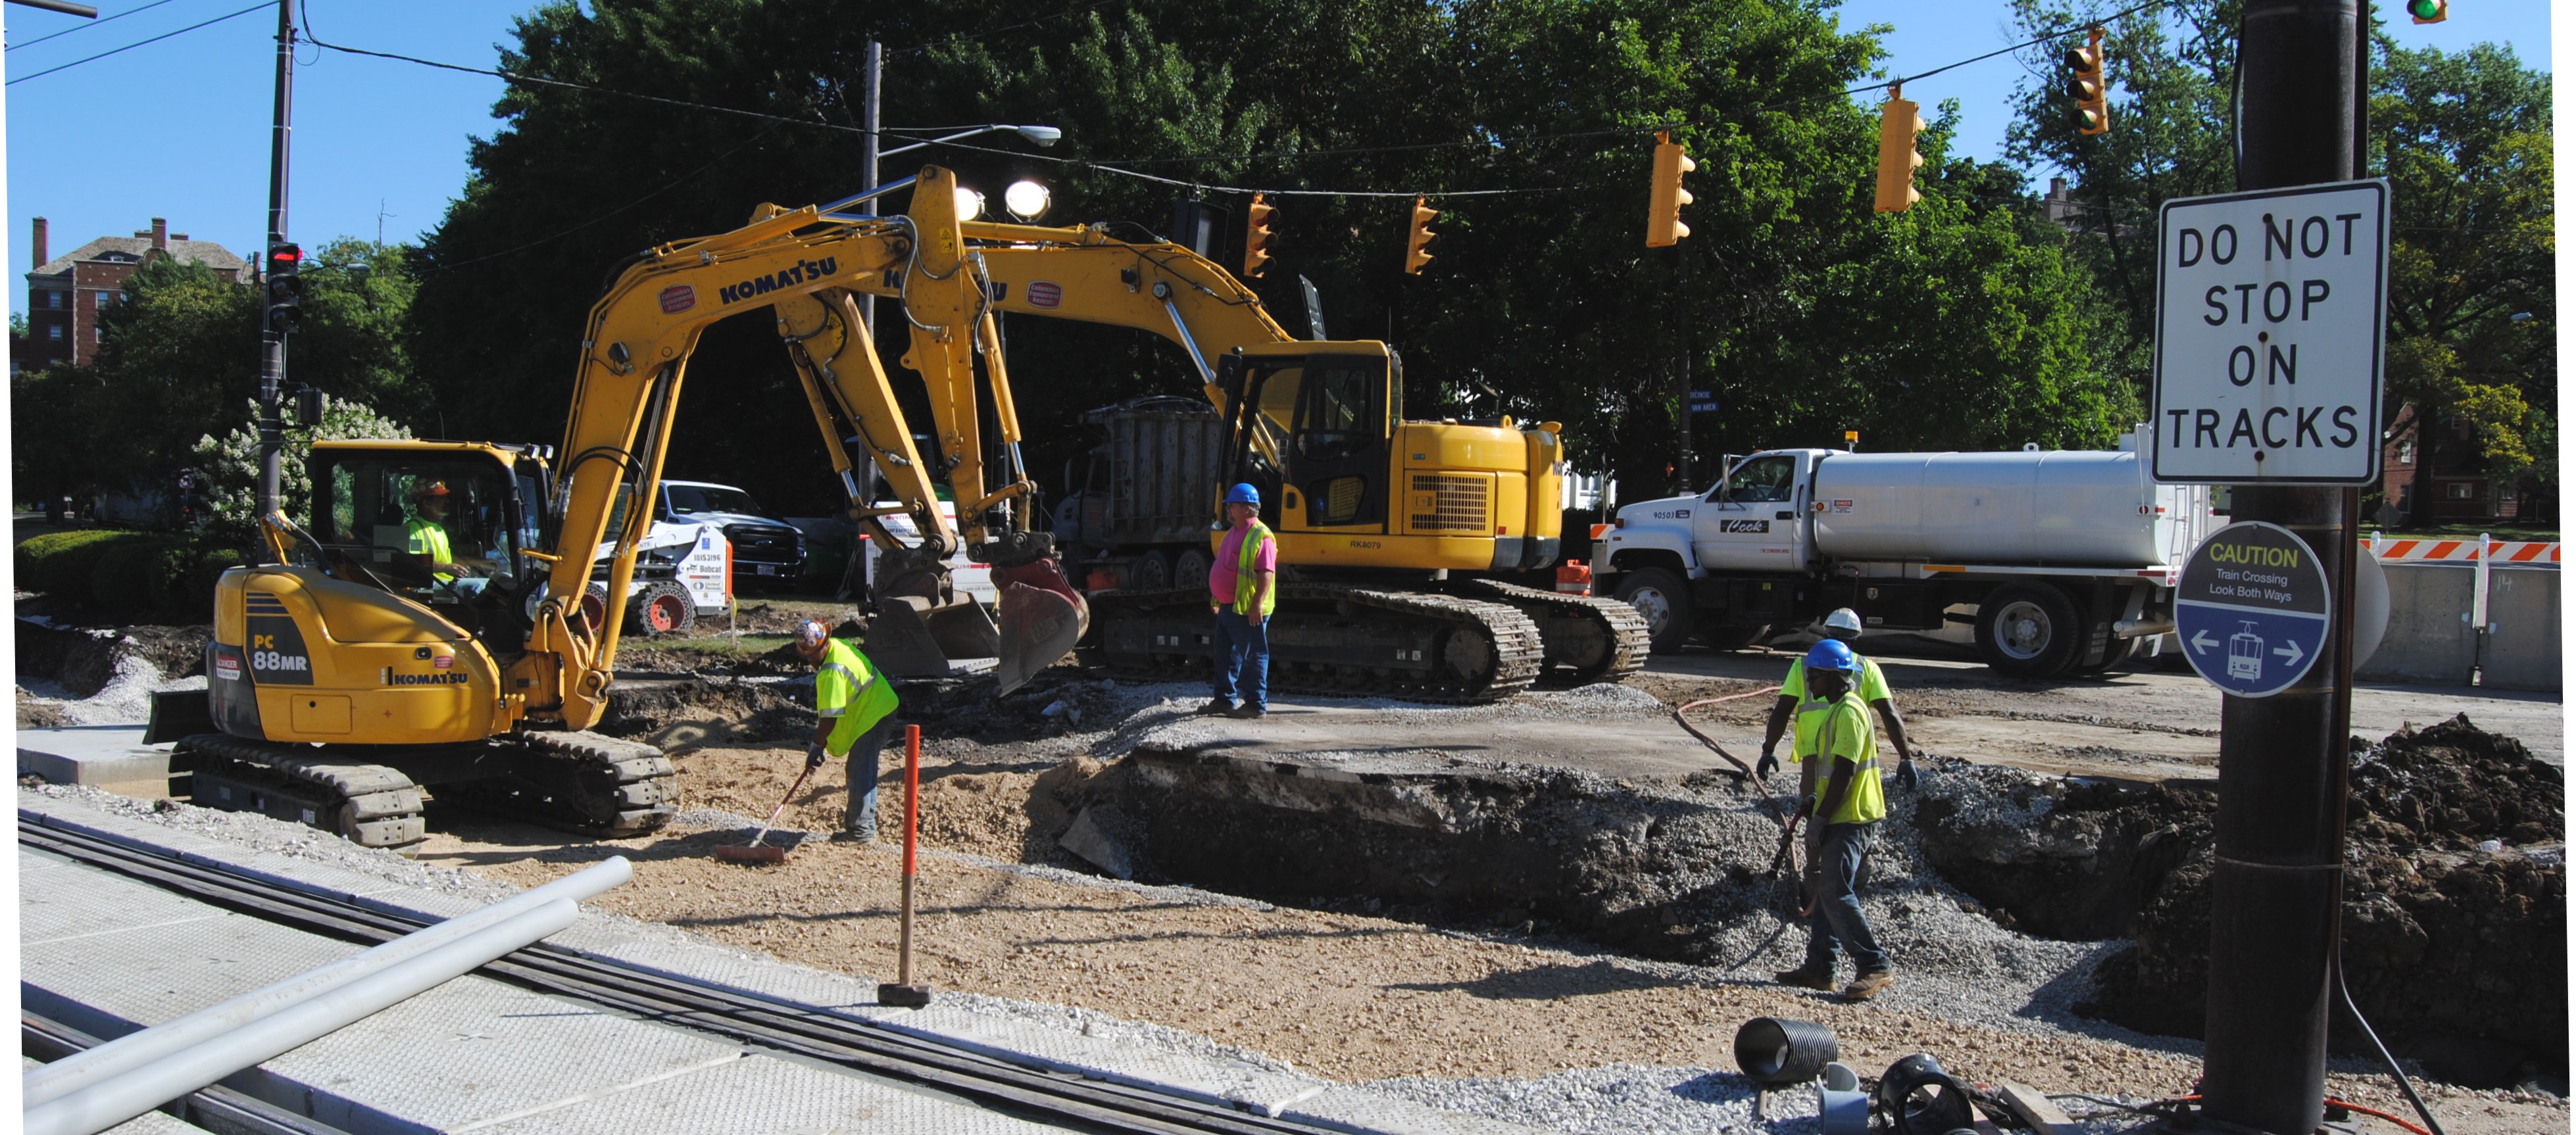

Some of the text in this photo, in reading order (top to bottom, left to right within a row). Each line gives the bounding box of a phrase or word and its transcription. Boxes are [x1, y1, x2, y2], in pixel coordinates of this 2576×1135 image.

[2178, 212, 2362, 268] DO NOT
[719, 256, 837, 305] KOMATSU
[2203, 279, 2331, 327] STOP
[2228, 343, 2296, 387] ON
[2167, 405, 2358, 448] TRACKS
[1727, 519, 1763, 535] Cook
[1350, 541, 1381, 549] RK8079
[2210, 543, 2298, 569] CAUTION
[2216, 568, 2289, 587] Train Crossing
[2210, 583, 2292, 603] Look Both Ways
[254, 635, 274, 649] PC
[254, 651, 307, 671] 88MR
[395, 671, 468, 685] KOMATSU
